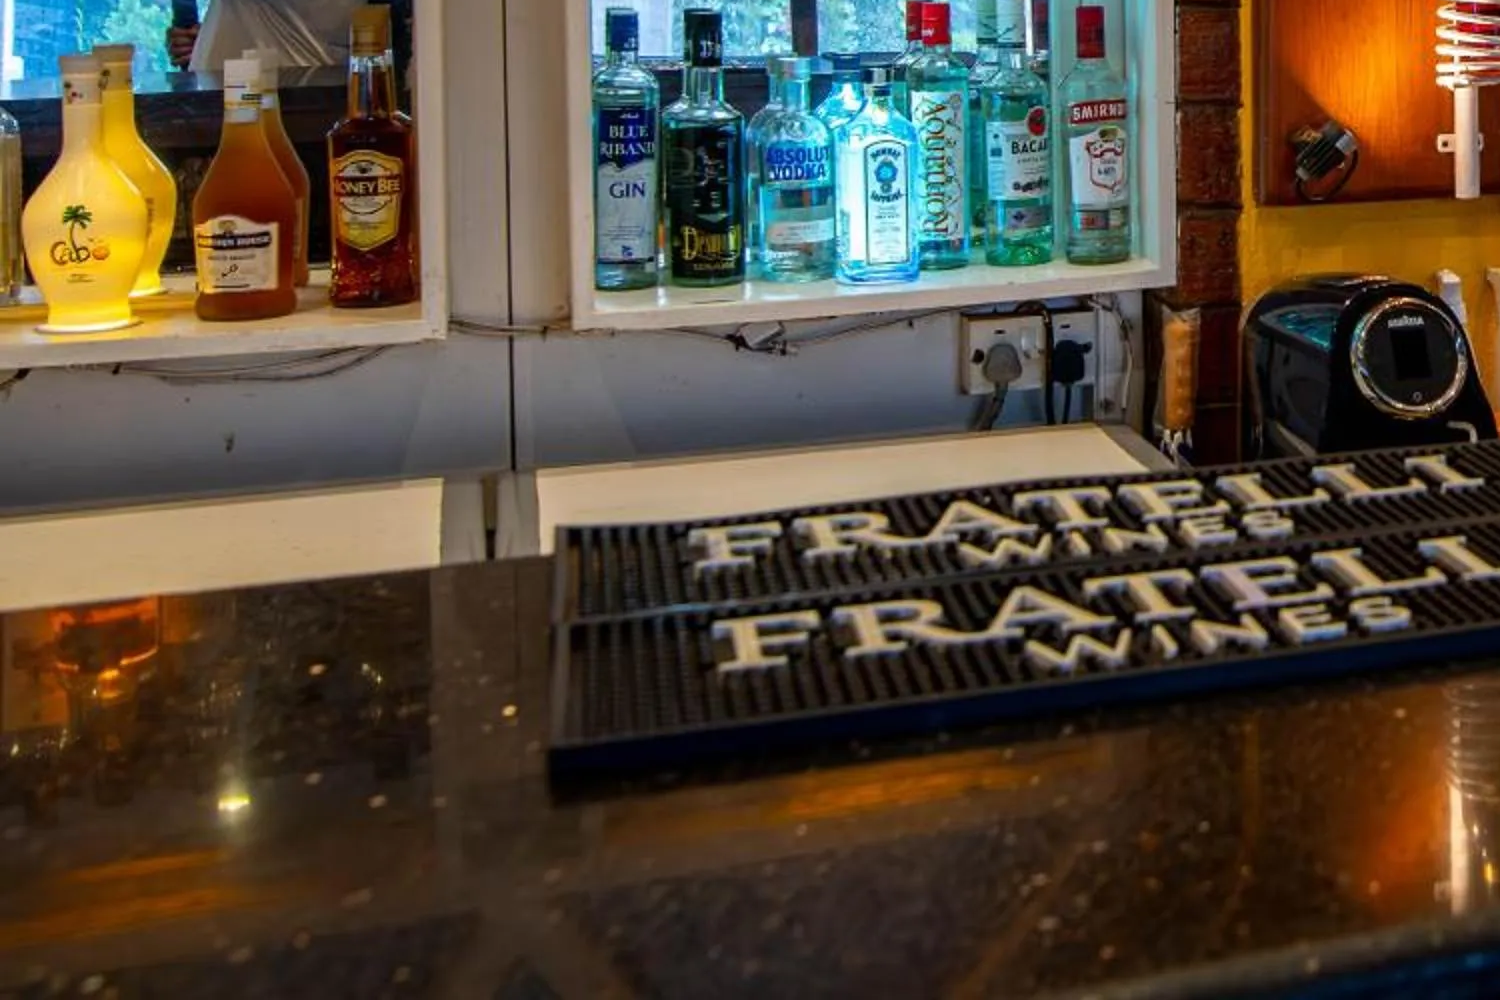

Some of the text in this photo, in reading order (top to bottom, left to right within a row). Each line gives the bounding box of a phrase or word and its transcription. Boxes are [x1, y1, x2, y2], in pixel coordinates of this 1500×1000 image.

[608, 124, 649, 139] BLUE
[766, 145, 830, 165] ABSOLUT
[769, 161, 827, 180] VODKA
[608, 181, 646, 199] GIN
[687, 454, 1485, 573] FRATELLI
[958, 510, 1295, 569] WINES
[1024, 595, 1412, 673] WINES
